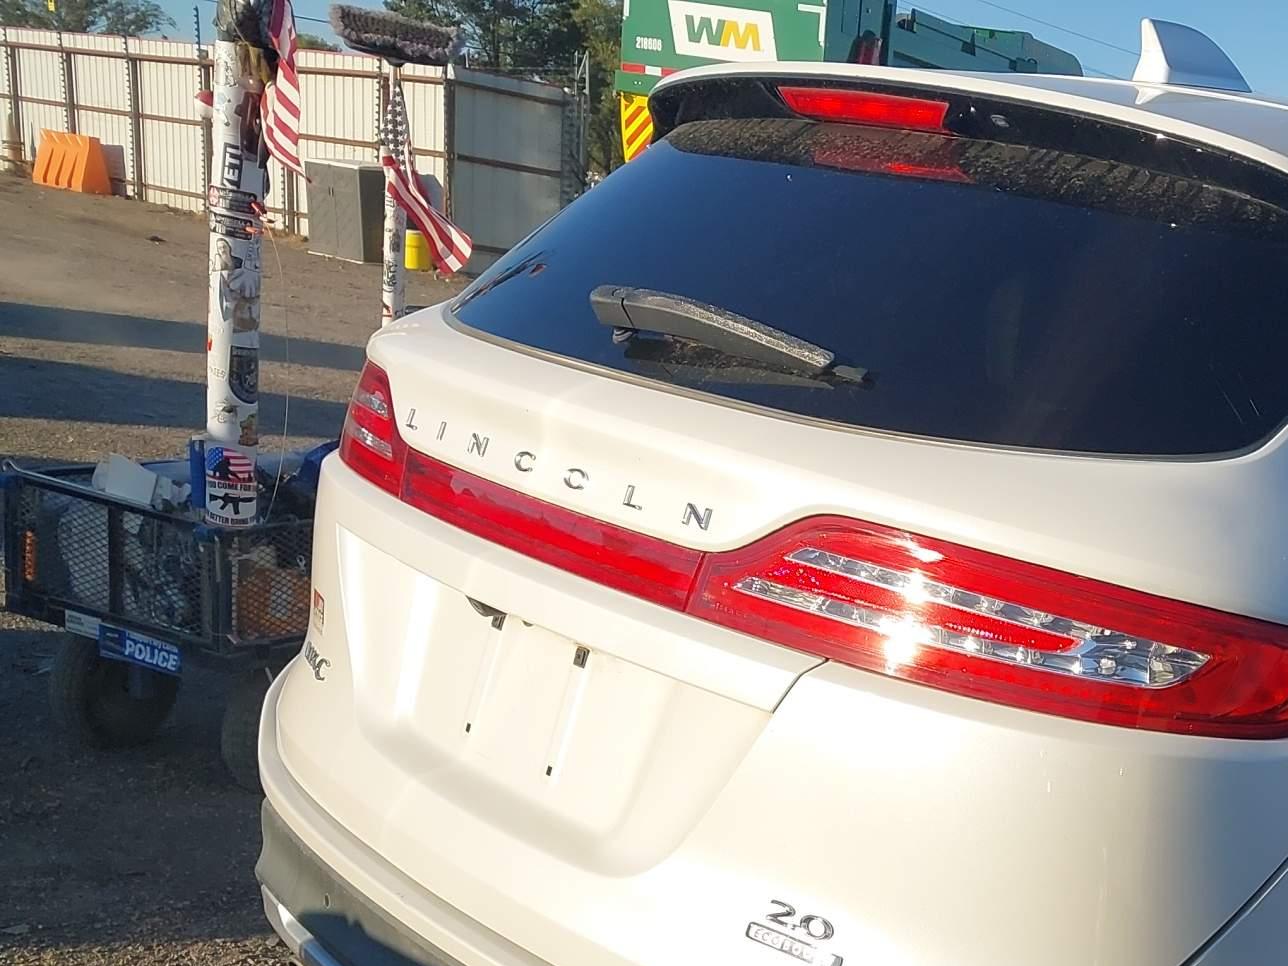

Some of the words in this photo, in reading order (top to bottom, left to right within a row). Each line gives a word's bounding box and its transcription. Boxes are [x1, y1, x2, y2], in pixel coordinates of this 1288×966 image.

[685, 14, 761, 52] WM
[222, 146, 241, 190] YETI
[217, 481, 238, 490] COME
[404, 408, 713, 531] LINCOLN
[124, 639, 178, 671] POLICE
[765, 899, 834, 941] 2.0
